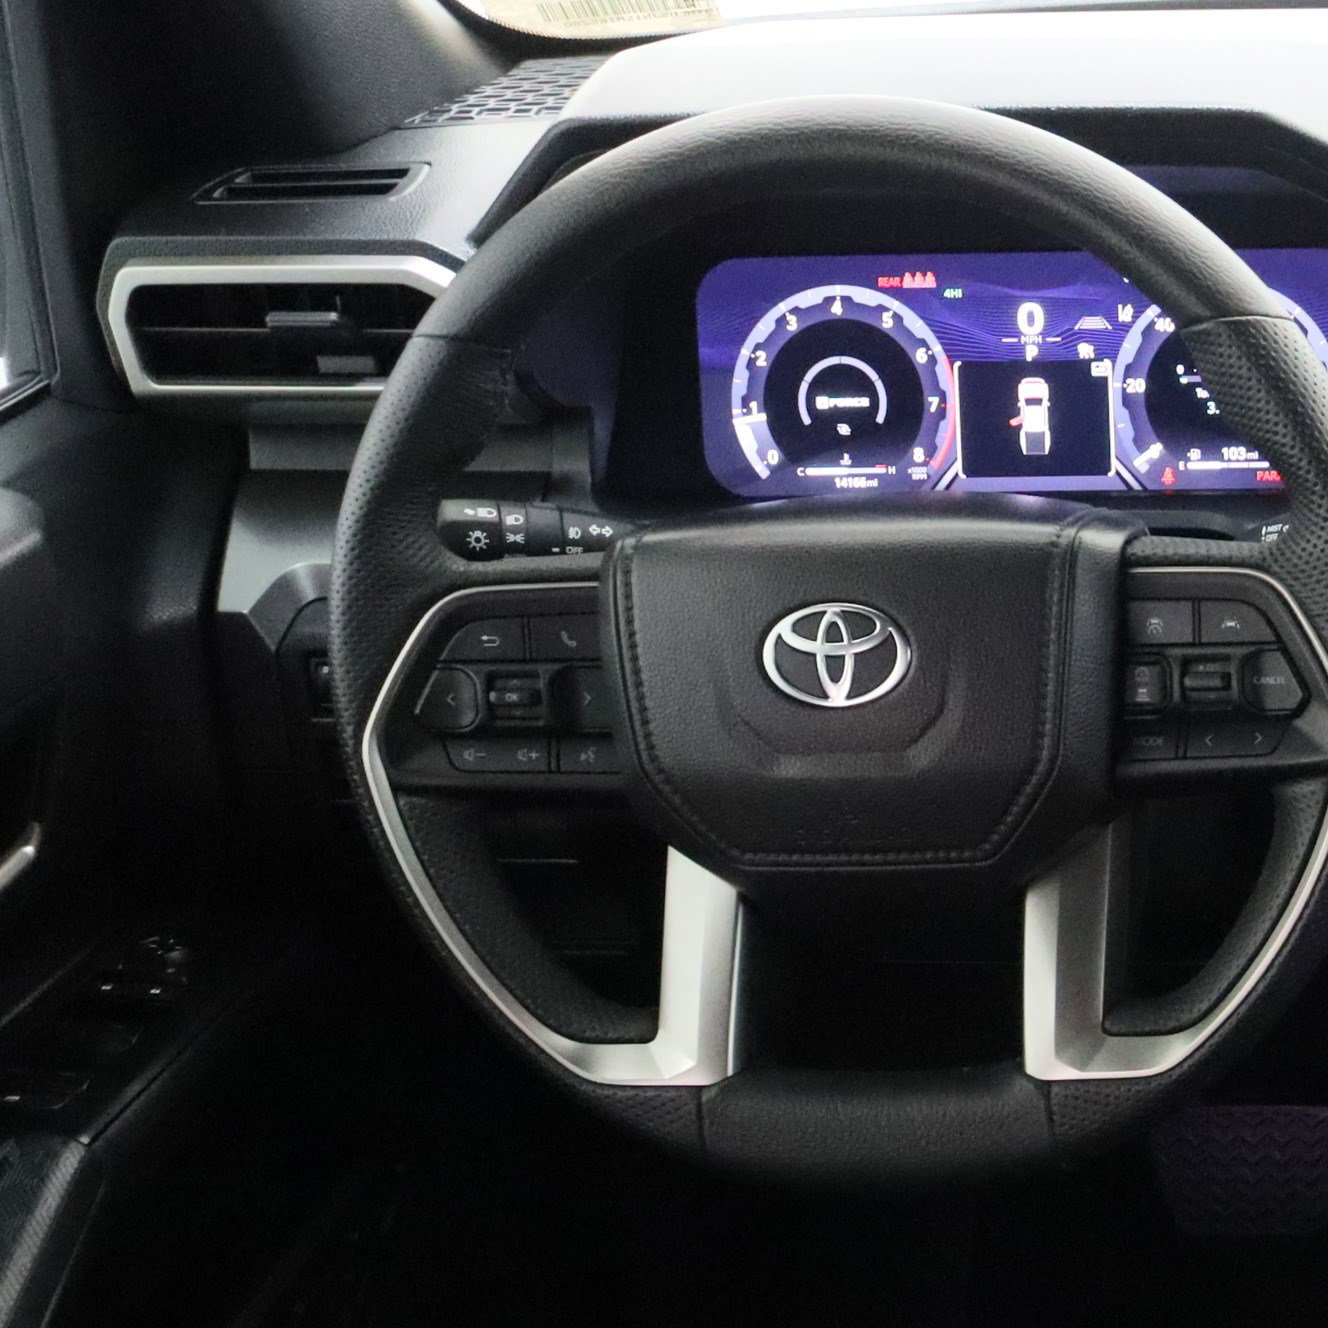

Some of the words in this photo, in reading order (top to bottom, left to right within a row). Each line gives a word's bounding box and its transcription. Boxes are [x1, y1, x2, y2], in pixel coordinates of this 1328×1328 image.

[877, 277, 902, 288] REAR
[943, 288, 963, 299] 4HI
[831, 300, 843, 315] 4
[786, 316, 798, 331] 3
[882, 314, 894, 328] 5
[1017, 303, 1045, 335] 0
[1020, 335, 1043, 344] MPH
[756, 351, 768, 366] 2
[915, 349, 928, 364] 6
[1025, 344, 1039, 362] P
[1126, 379, 1146, 393] 20
[749, 402, 758, 415] 1
[928, 397, 939, 412] 7
[767, 450, 779, 464] 0
[913, 447, 925, 462] 8
[796, 467, 805, 476] C
[888, 466, 896, 475] H
[1178, 462, 1186, 471] E
[911, 473, 929, 481] RPM
[1256, 471, 1282, 482] PAR
[1266, 523, 1283, 533] MIST
[565, 546, 584, 554] OFF
[1253, 676, 1286, 684] CANCEL
[504, 693, 520, 701] OK
